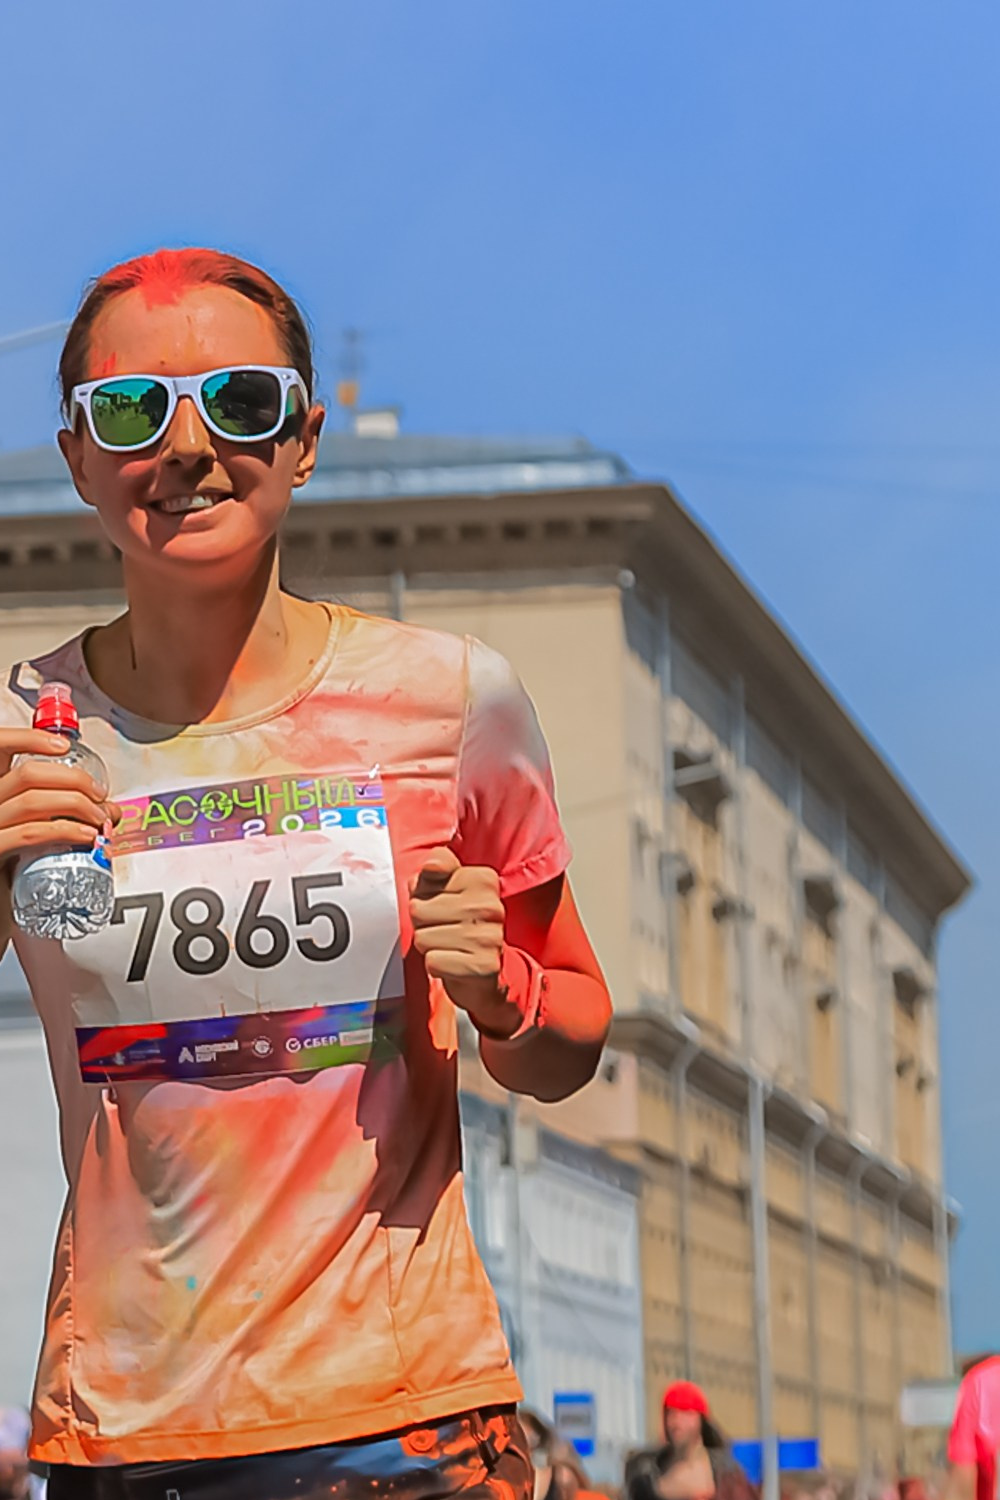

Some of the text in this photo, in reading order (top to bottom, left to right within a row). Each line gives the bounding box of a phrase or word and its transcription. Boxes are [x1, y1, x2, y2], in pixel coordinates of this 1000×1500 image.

[112, 774, 356, 836] РАСОЧНЫЙ
[242, 808, 381, 839] 2026
[110, 872, 353, 983] 7865
[303, 1035, 338, 1048] СБЕР
